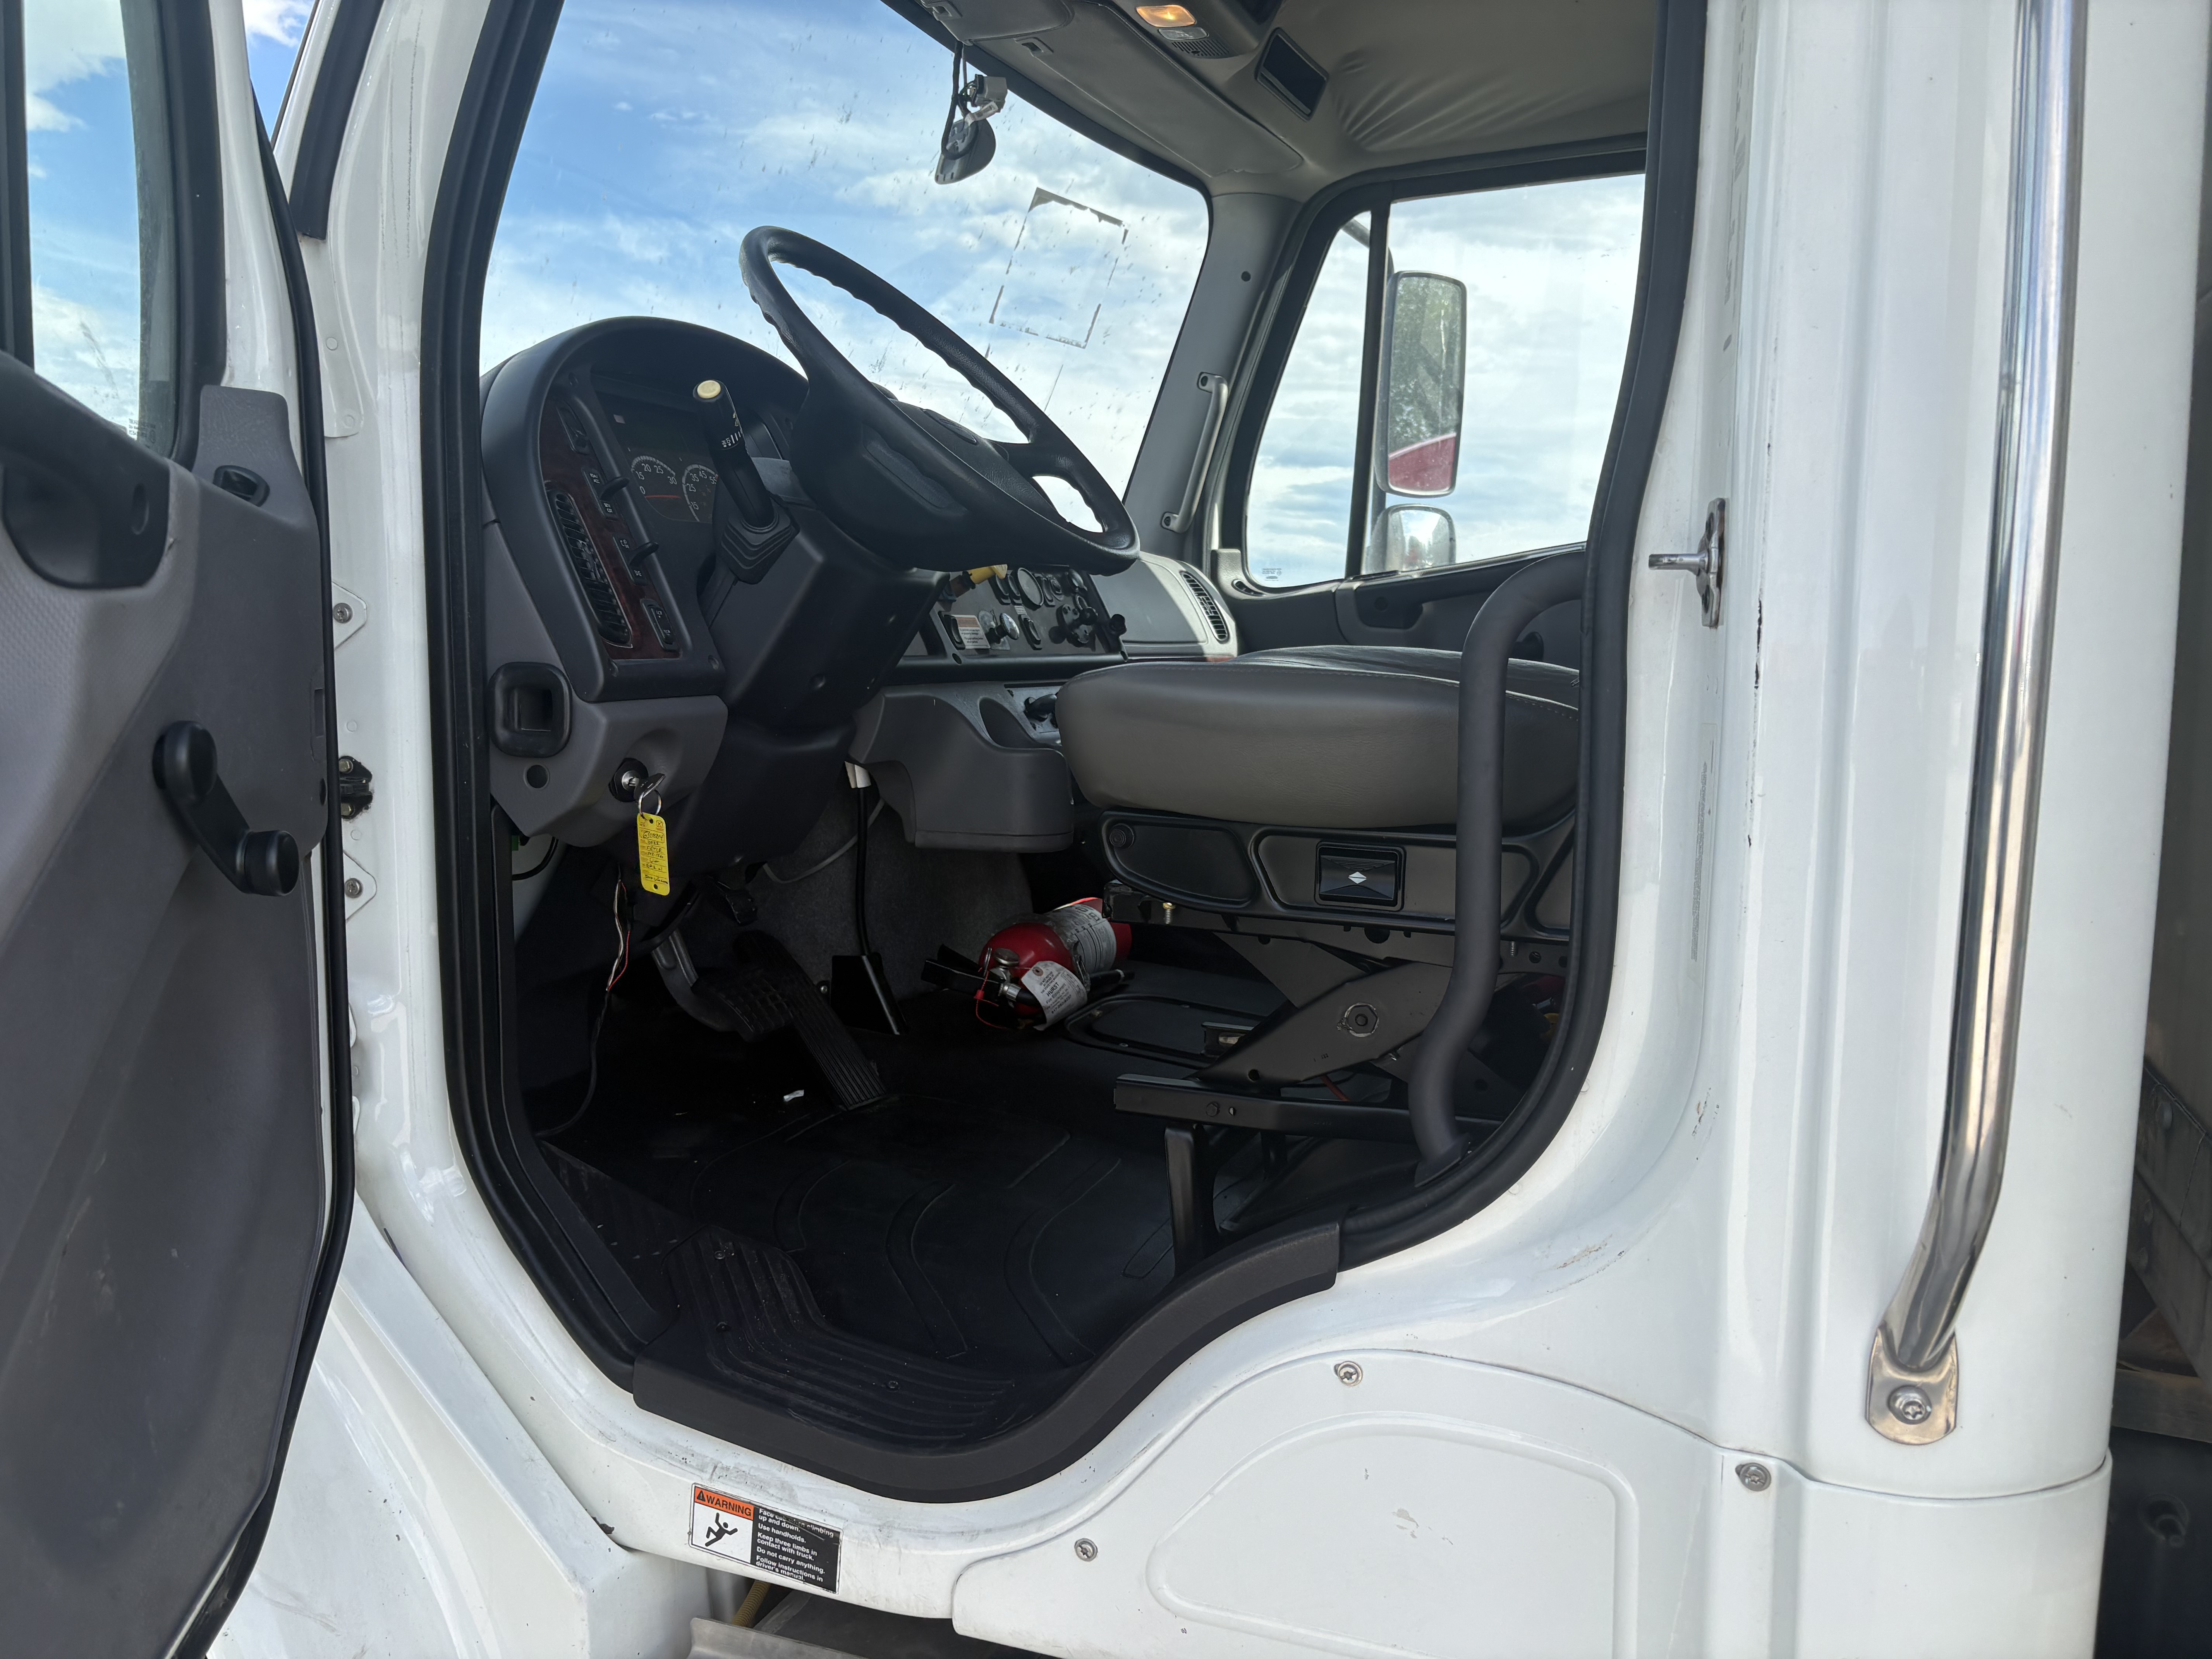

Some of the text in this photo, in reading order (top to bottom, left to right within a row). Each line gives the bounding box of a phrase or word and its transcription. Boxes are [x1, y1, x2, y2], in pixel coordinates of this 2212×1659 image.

[642, 464, 651, 472] 20
[654, 465, 664, 474] 25
[635, 471, 644, 480] 15
[667, 476, 677, 484] 30
[690, 474, 699, 482] 35
[709, 476, 717, 484] 55
[639, 486, 646, 495] 0
[687, 484, 696, 492] 25
[691, 502, 699, 510] 15
[1046, 982, 1060, 997] HURST
[706, 1494, 752, 1516] WARNING
[759, 1508, 774, 1518] Face
[781, 1521, 800, 1532] down.
[771, 1527, 806, 1543] handholds.
[757, 1532, 774, 1542] Keep
[775, 1538, 791, 1547] three
[792, 1543, 810, 1553] limbs
[757, 1539, 814, 1561] contact with truck.
[756, 1555, 777, 1566] Follow
[778, 1562, 815, 1580] instructions
[778, 1554, 795, 1564] carry
[796, 1560, 825, 1574] anything.
[756, 1561, 805, 1581] driver's manual.
